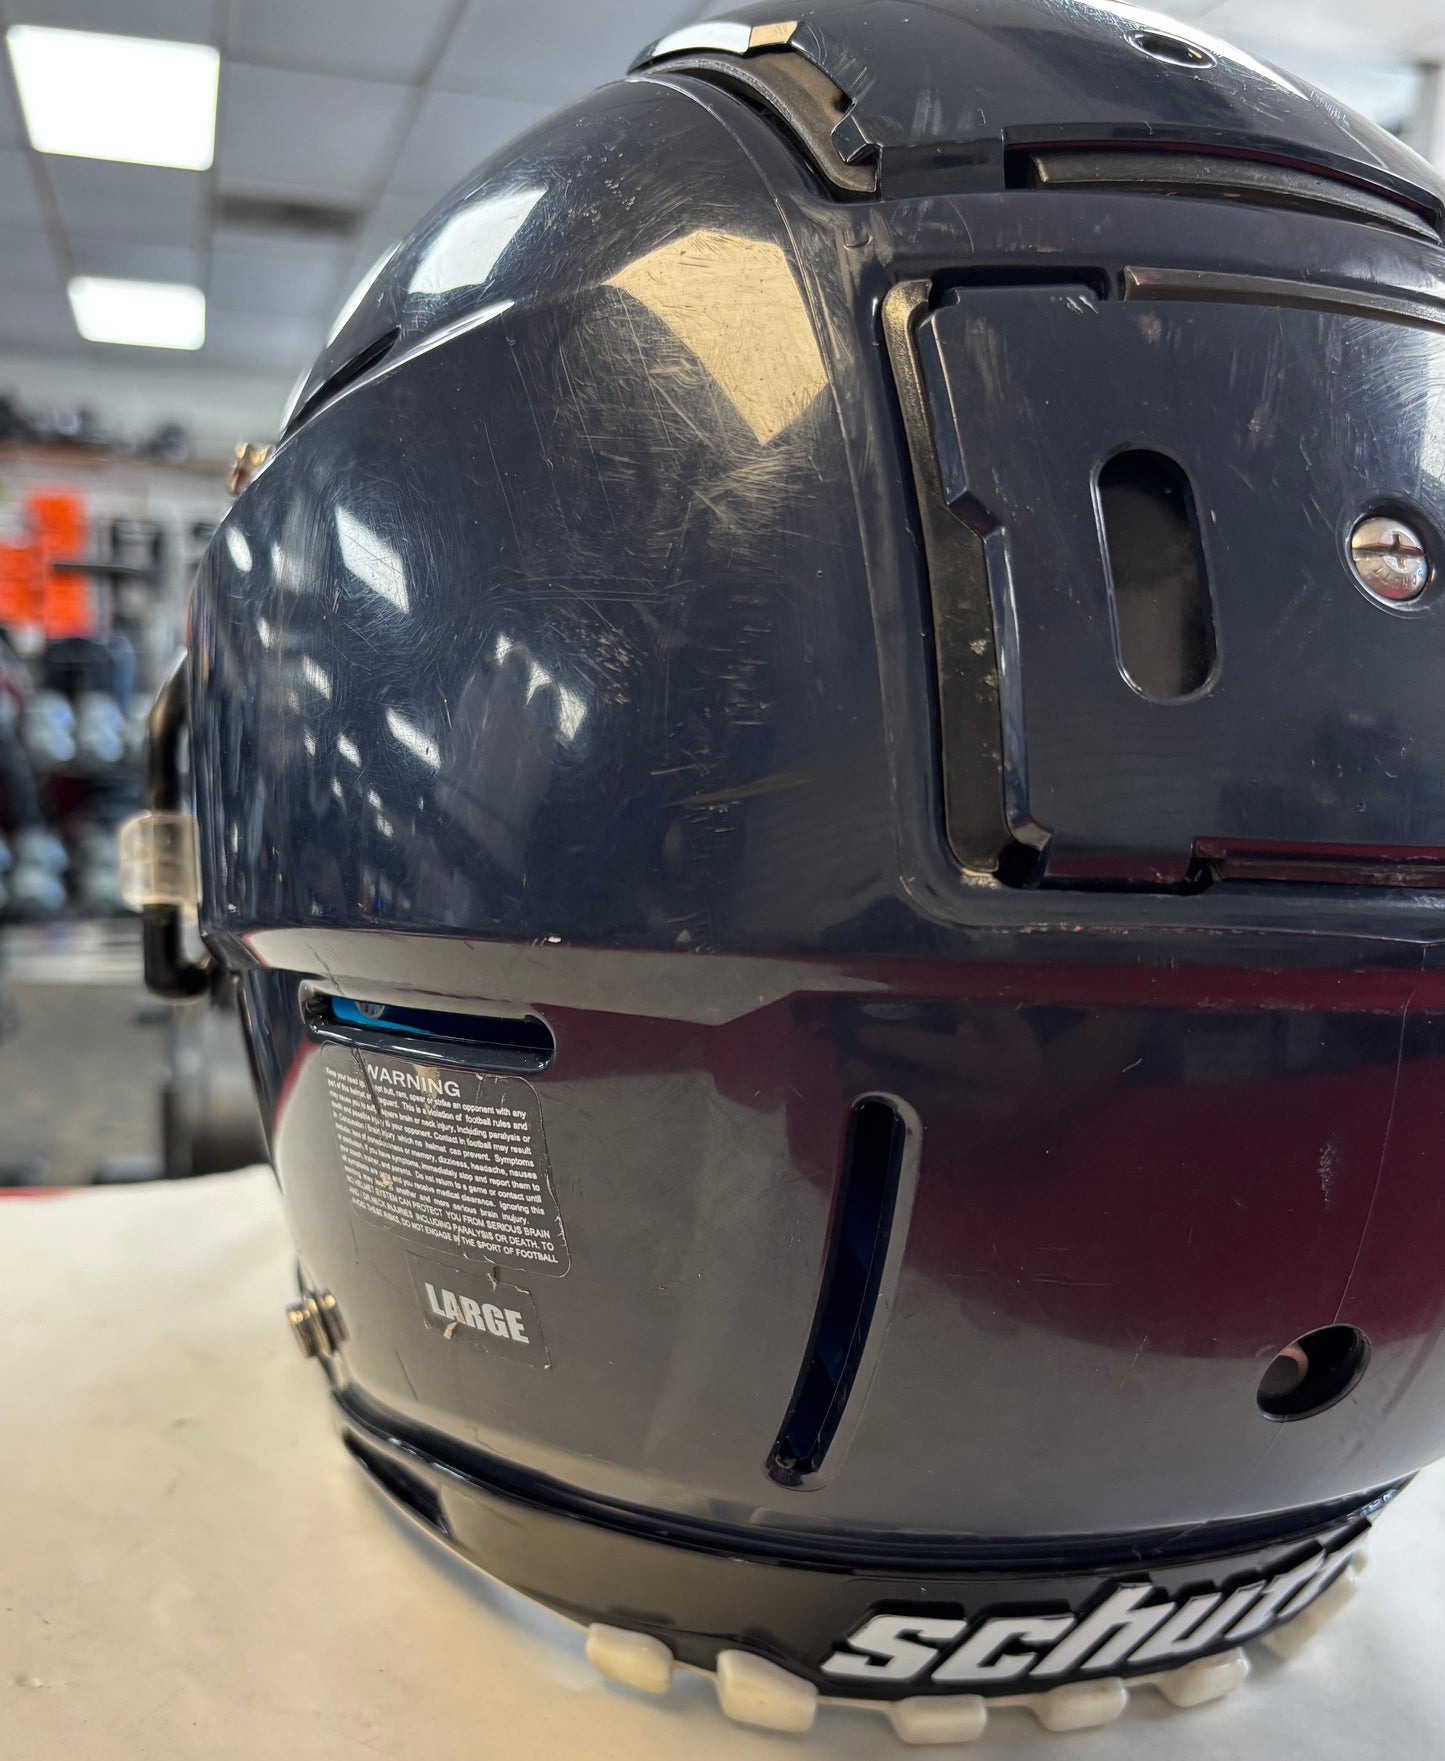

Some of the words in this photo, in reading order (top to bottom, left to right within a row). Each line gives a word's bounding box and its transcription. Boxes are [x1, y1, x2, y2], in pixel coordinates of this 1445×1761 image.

[402, 1101, 415, 1112] This
[427, 1107, 454, 1120] violation
[455, 1113, 463, 1121] of
[465, 1114, 491, 1126] football
[492, 1119, 511, 1129] rules
[513, 1122, 528, 1131] and
[410, 1094, 425, 1103] spear
[434, 1098, 451, 1108] strike
[452, 1102, 461, 1110] an
[462, 1103, 495, 1114] opponent
[495, 1107, 511, 1116] with
[512, 1110, 526, 1120] any
[391, 1122, 403, 1131] your
[403, 1126, 432, 1139] opponent.
[433, 1131, 458, 1144] Contact
[466, 1137, 492, 1150] football
[493, 1143, 509, 1154] may
[399, 1112, 413, 1123] brain
[421, 1119, 436, 1128] neck
[437, 1120, 456, 1133] injury,
[457, 1125, 487, 1139] including
[488, 1131, 521, 1142] paralysis
[522, 1135, 531, 1143] or
[381, 1129, 395, 1141] injury
[397, 1134, 414, 1145] which
[414, 1140, 423, 1148] no
[449, 1147, 462, 1156] can
[463, 1150, 491, 1161] prevent.
[494, 1154, 535, 1168] Symptoms
[411, 1149, 437, 1163] memory,
[438, 1155, 470, 1170] dizziness,
[470, 1161, 508, 1176] headache,
[391, 1154, 420, 1169] symptoms,
[421, 1161, 457, 1179] immediately
[458, 1171, 473, 1182] stop
[474, 1175, 488, 1184] and
[489, 1177, 511, 1187] report
[511, 1180, 531, 1190] them
[532, 1183, 541, 1192] to
[391, 1165, 413, 1176] parents.
[415, 1170, 424, 1180] Do
[424, 1174, 435, 1183] not
[435, 1177, 454, 1188] return
[454, 1181, 462, 1189] to
[468, 1185, 488, 1195] game
[497, 1190, 525, 1201] contact
[525, 1194, 542, 1203] until
[375, 1187, 398, 1203] SYSTEM
[398, 1196, 412, 1208] CAN
[411, 1200, 442, 1217] PROTECT
[445, 1210, 462, 1222] YOU
[462, 1214, 485, 1228] FROM
[486, 1220, 522, 1235] SERIOUS
[523, 1227, 551, 1240] BRAIN
[395, 1186, 417, 1199] another
[419, 1194, 431, 1203] and
[433, 1198, 450, 1208] more
[452, 1203, 477, 1215] serious
[480, 1207, 499, 1219] brain
[402, 1178, 414, 1188] you
[413, 1181, 435, 1193] receive
[435, 1188, 460, 1200] medical
[460, 1193, 496, 1207] clearance.
[499, 1200, 529, 1215] Ignoring
[530, 1205, 545, 1216] this
[370, 1195, 387, 1209] NECK
[415, 1212, 452, 1231] INCLUDING
[452, 1222, 493, 1241] PARALYSIS
[494, 1233, 509, 1244] OR
[508, 1235, 541, 1250] DEATH.
[541, 1241, 555, 1252] TO
[401, 1217, 411, 1228] DO
[411, 1221, 424, 1232] NOT
[424, 1225, 453, 1241] ENGAGE
[461, 1236, 476, 1248] THE
[476, 1240, 502, 1253] SPORT
[503, 1246, 515, 1255] OF
[515, 1248, 559, 1264] FOOTBALL
[424, 1282, 530, 1344] LARGE
